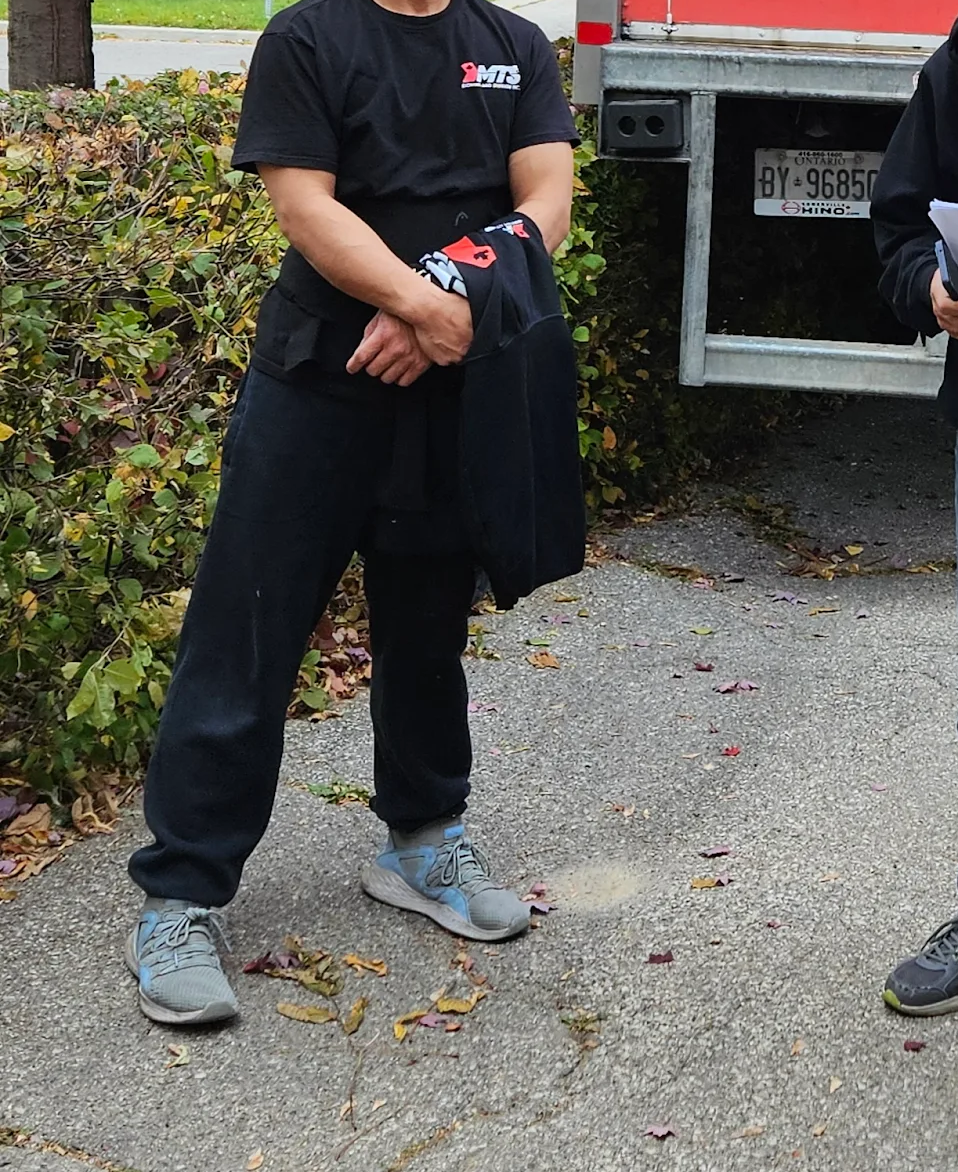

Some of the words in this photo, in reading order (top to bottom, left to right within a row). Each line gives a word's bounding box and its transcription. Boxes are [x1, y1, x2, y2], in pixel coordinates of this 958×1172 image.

[476, 64, 522, 85] MTS
[795, 156, 846, 166] ONTARIO
[762, 165, 790, 200] BY
[801, 207, 846, 216] HINO
